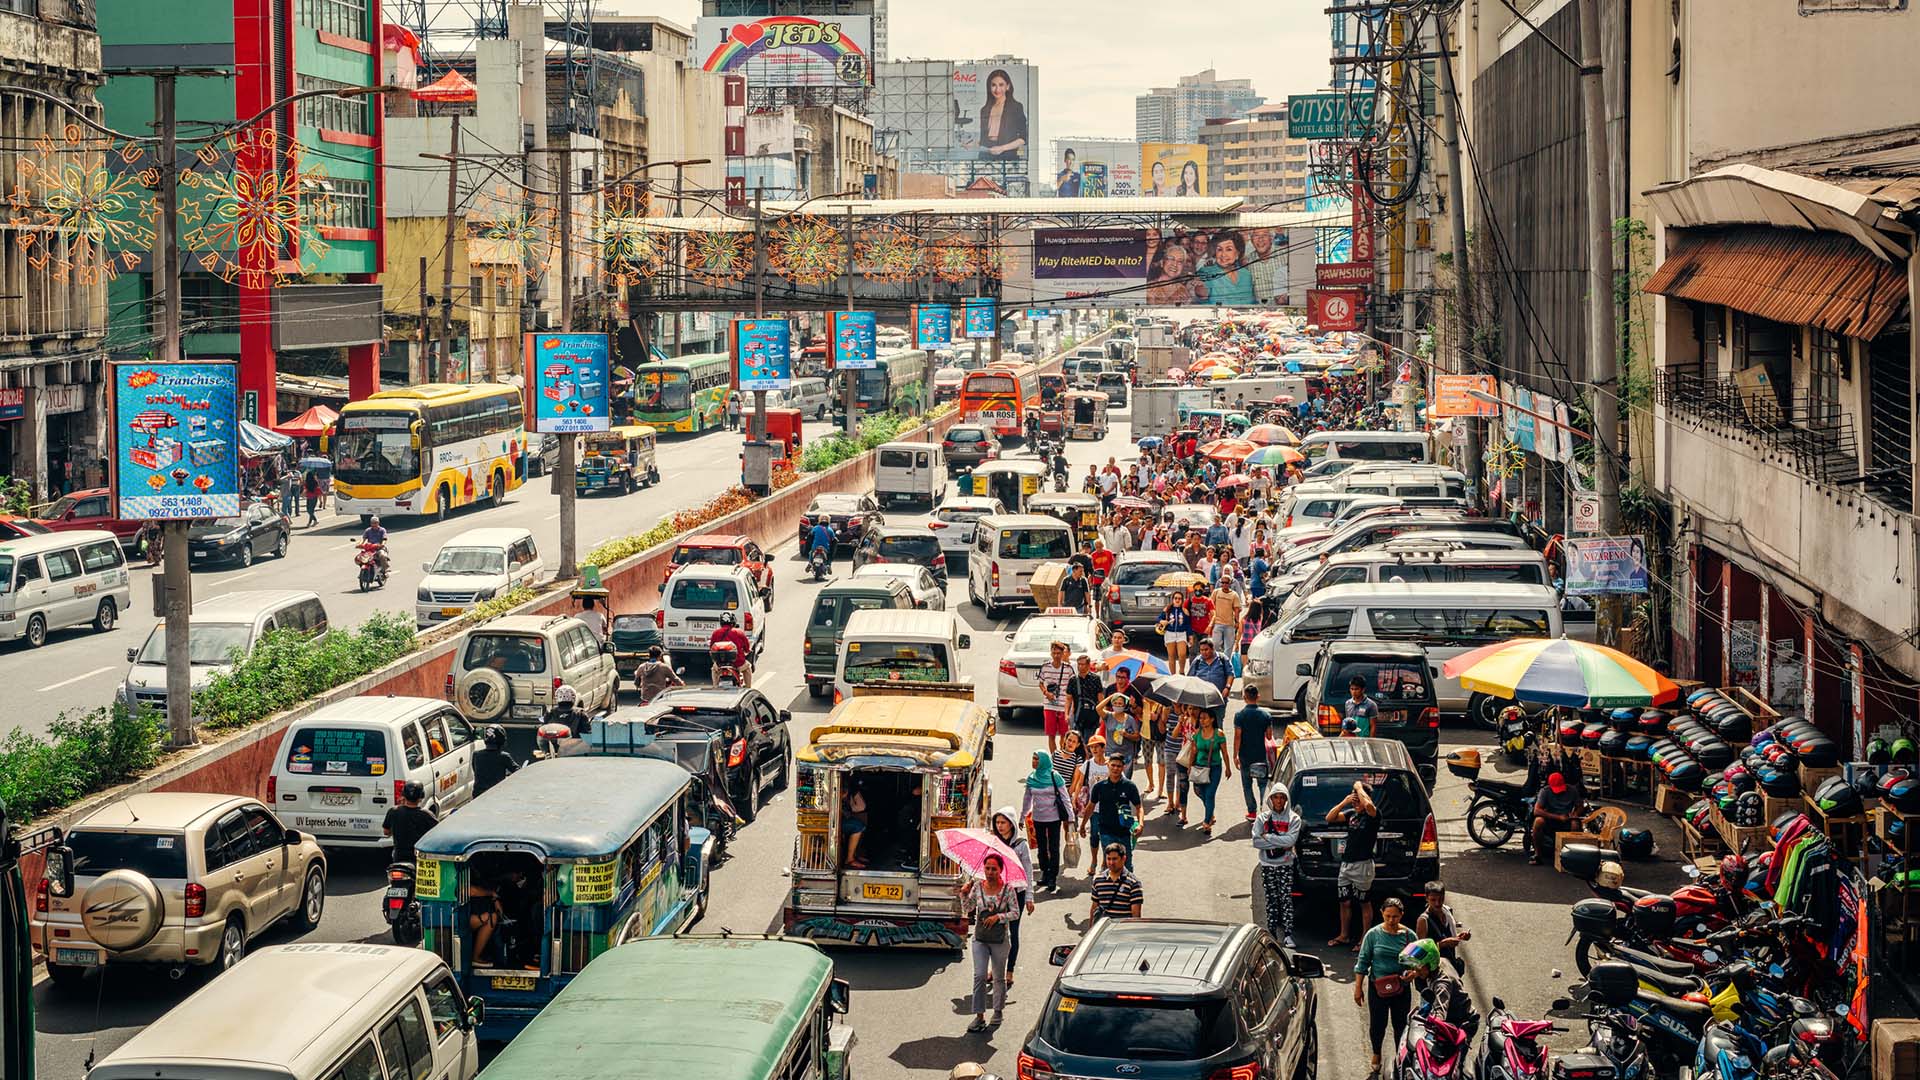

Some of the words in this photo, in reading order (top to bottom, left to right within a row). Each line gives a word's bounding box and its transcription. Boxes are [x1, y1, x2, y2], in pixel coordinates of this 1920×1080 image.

[720, 27, 728, 43] I
[765, 22, 841, 49] JED'S
[841, 61, 862, 74] 24
[1038, 256, 1060, 268] May
[1061, 256, 1102, 266] RiteMED
[1104, 256, 1116, 266] ba
[1118, 256, 1143, 266] nito?
[1318, 267, 1373, 279] PAWNSHOP
[160, 374, 222, 386] Franchise
[161, 497, 178, 507] 563
[180, 497, 202, 506] 1408
[148, 508, 171, 517] 0927
[172, 507, 189, 517] 011
[190, 506, 213, 516] 8000
[1583, 551, 1626, 561] NAZARENO
[857, 727, 893, 735] ANTONIO
[894, 729, 929, 737] SPURS
[295, 816, 305, 826] UV
[305, 817, 326, 828] Express
[327, 817, 347, 827] Service
[867, 886, 881, 896] TWZ
[886, 887, 900, 896] 122
[1121, 1064, 1137, 1073] Ford
